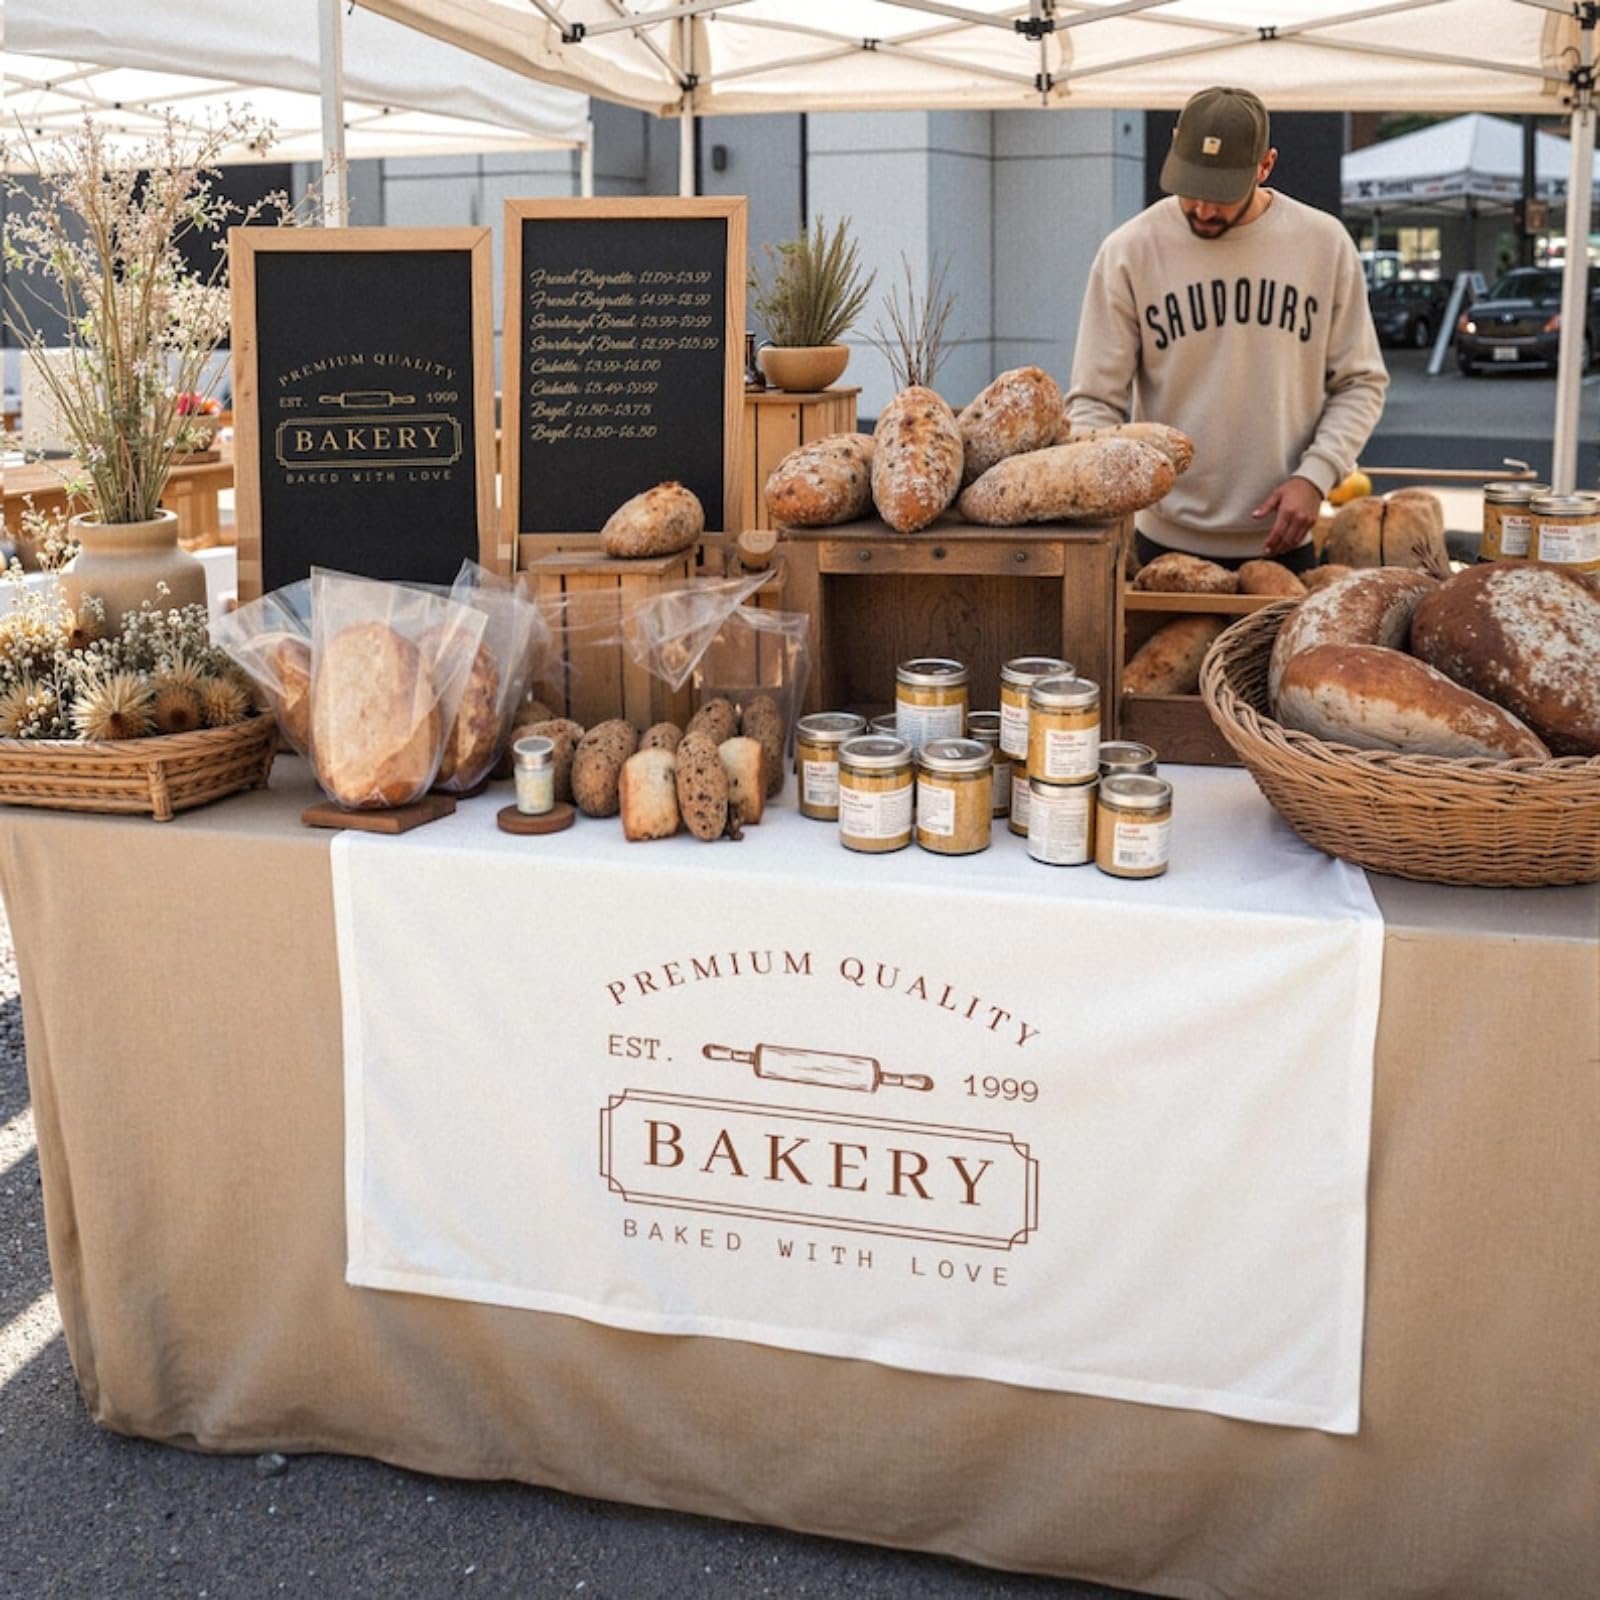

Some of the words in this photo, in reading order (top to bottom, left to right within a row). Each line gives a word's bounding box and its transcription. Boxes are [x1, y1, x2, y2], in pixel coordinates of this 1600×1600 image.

[530, 268, 578, 287] French
[530, 290, 578, 309] French
[530, 313, 596, 334] Sourdough
[1146, 277, 1318, 350] SAUDOURS
[530, 335, 596, 355] Sourdough
[278, 353, 365, 387] PREMIUM
[374, 353, 457, 381] QUALITY
[279, 395, 308, 408] EST.
[295, 426, 442, 452] BAKERY
[286, 472, 339, 484] BAKED
[352, 471, 396, 482] WITH
[409, 470, 453, 482] LOVE
[605, 949, 813, 1006] PREMIUM
[840, 956, 1040, 1049] QUALITY
[608, 1034, 672, 1062] EST.
[964, 1073, 1039, 1103] 1999
[643, 1119, 995, 1207] BAKERY
[624, 1218, 742, 1251] BAKED
[778, 1239, 873, 1269] WITH
[911, 1256, 1009, 1286] LOVE
